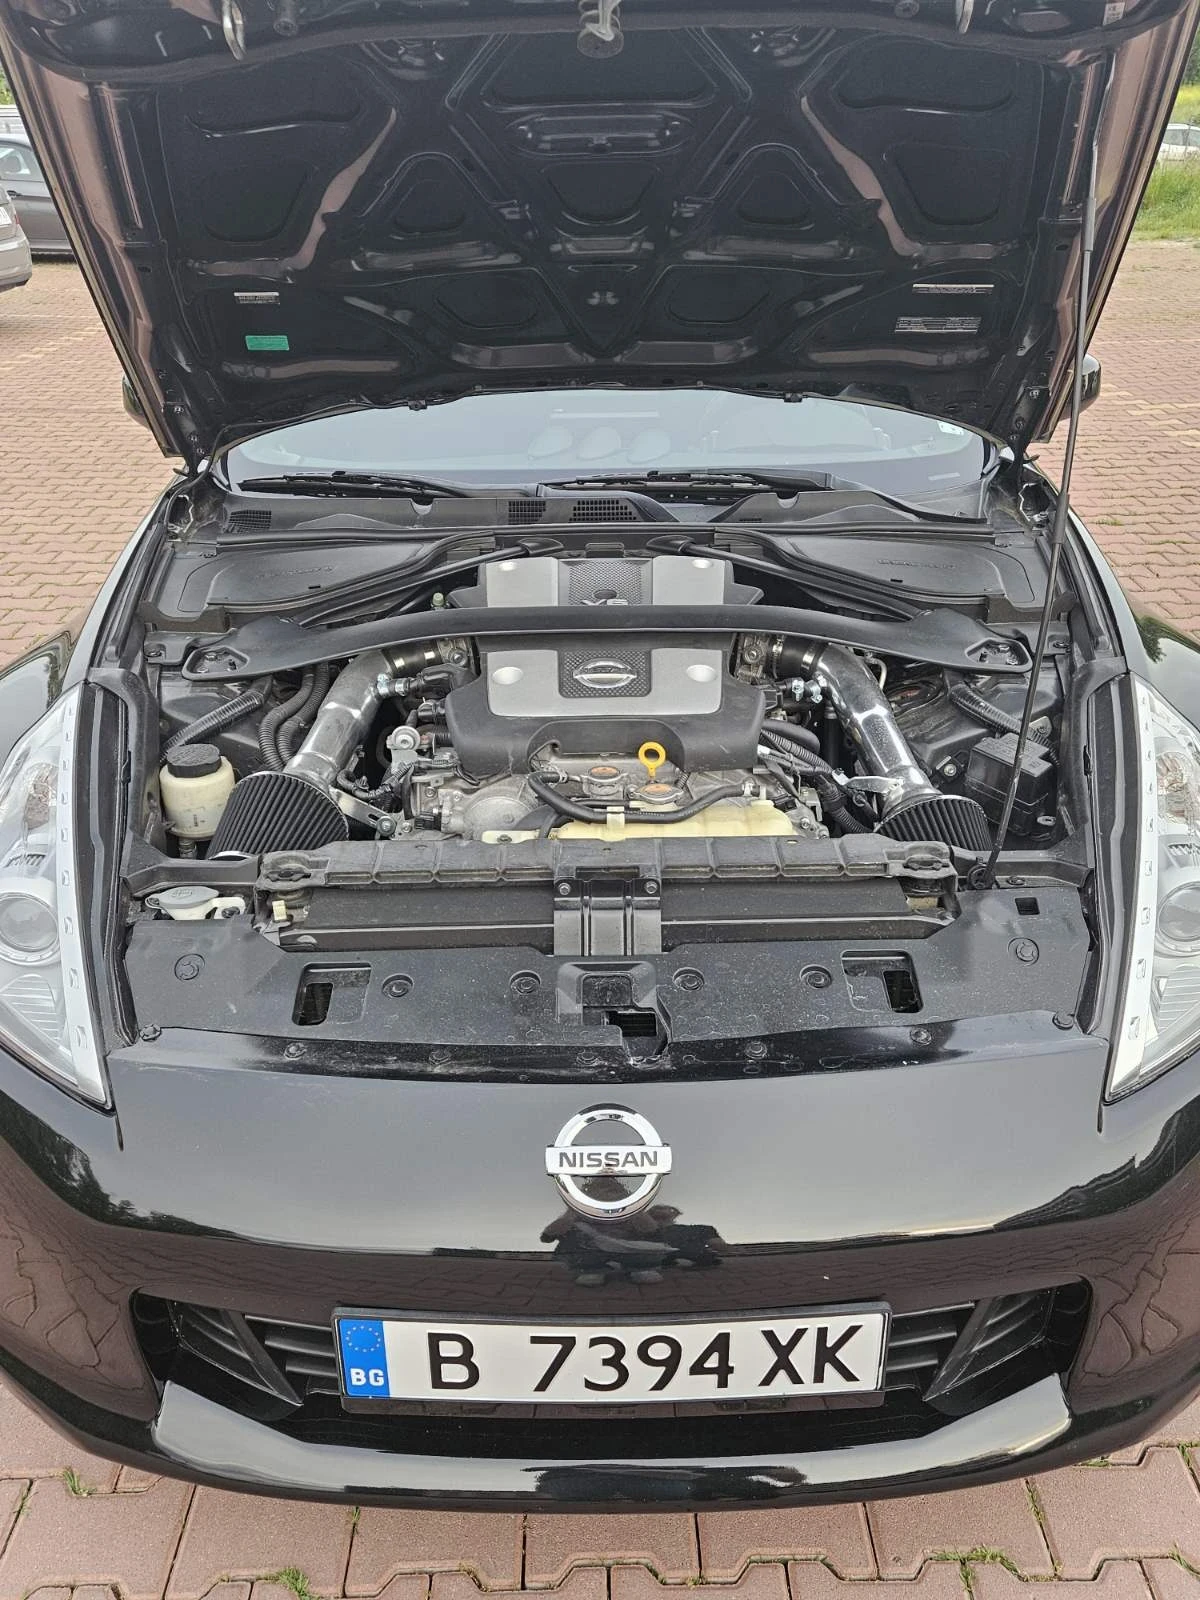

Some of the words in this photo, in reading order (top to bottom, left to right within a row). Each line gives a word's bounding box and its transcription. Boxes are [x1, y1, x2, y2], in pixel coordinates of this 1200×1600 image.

[558, 1151, 658, 1168] NISSAN
[427, 1332, 480, 1389] B
[529, 1332, 735, 1392] 7394
[757, 1324, 864, 1387] XK
[350, 1368, 385, 1387] BG
